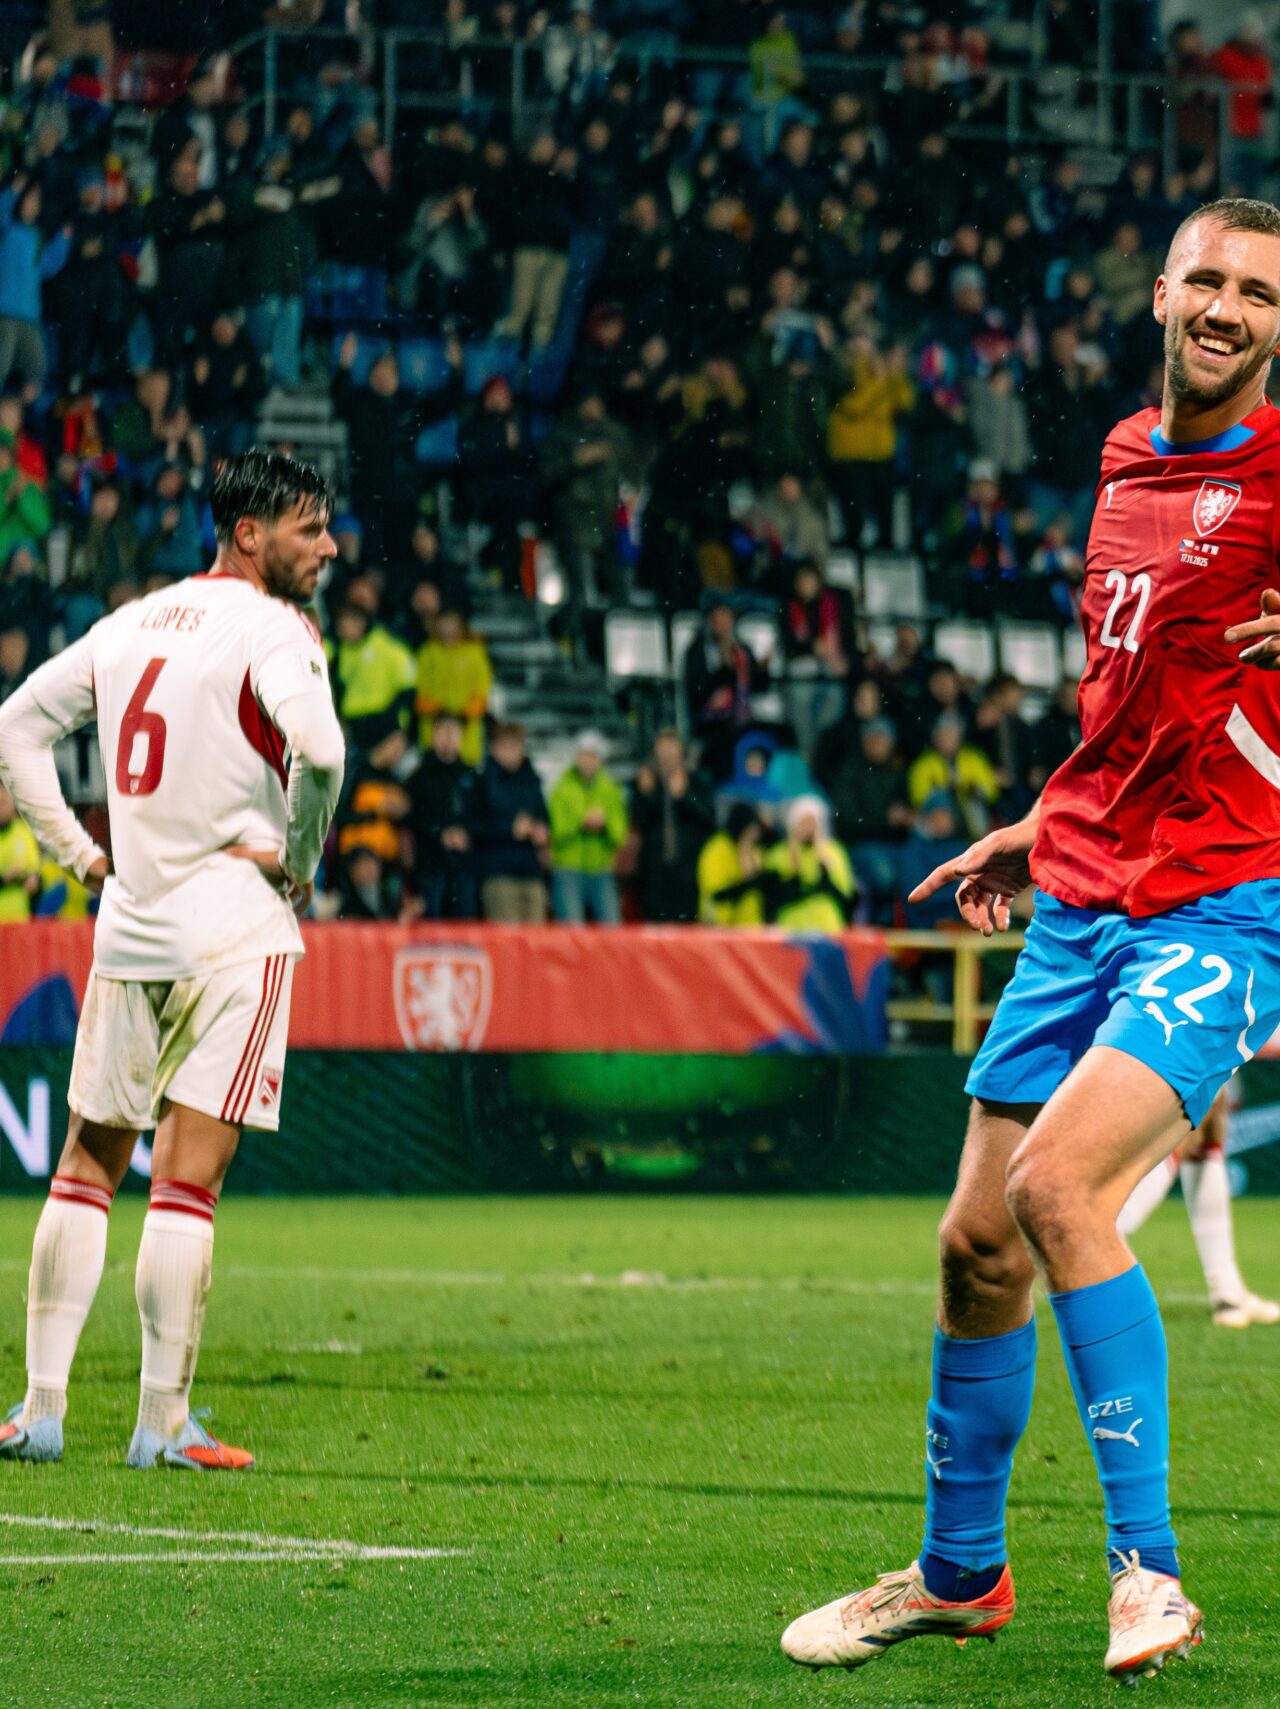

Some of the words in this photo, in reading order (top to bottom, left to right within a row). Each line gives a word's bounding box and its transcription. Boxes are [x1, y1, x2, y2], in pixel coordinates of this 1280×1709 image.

[139, 604, 207, 633] LOPES
[1100, 569, 1151, 654] 22
[115, 657, 168, 797] 6
[1137, 942, 1233, 1024] 22
[1088, 1397, 1134, 1419] CZE
